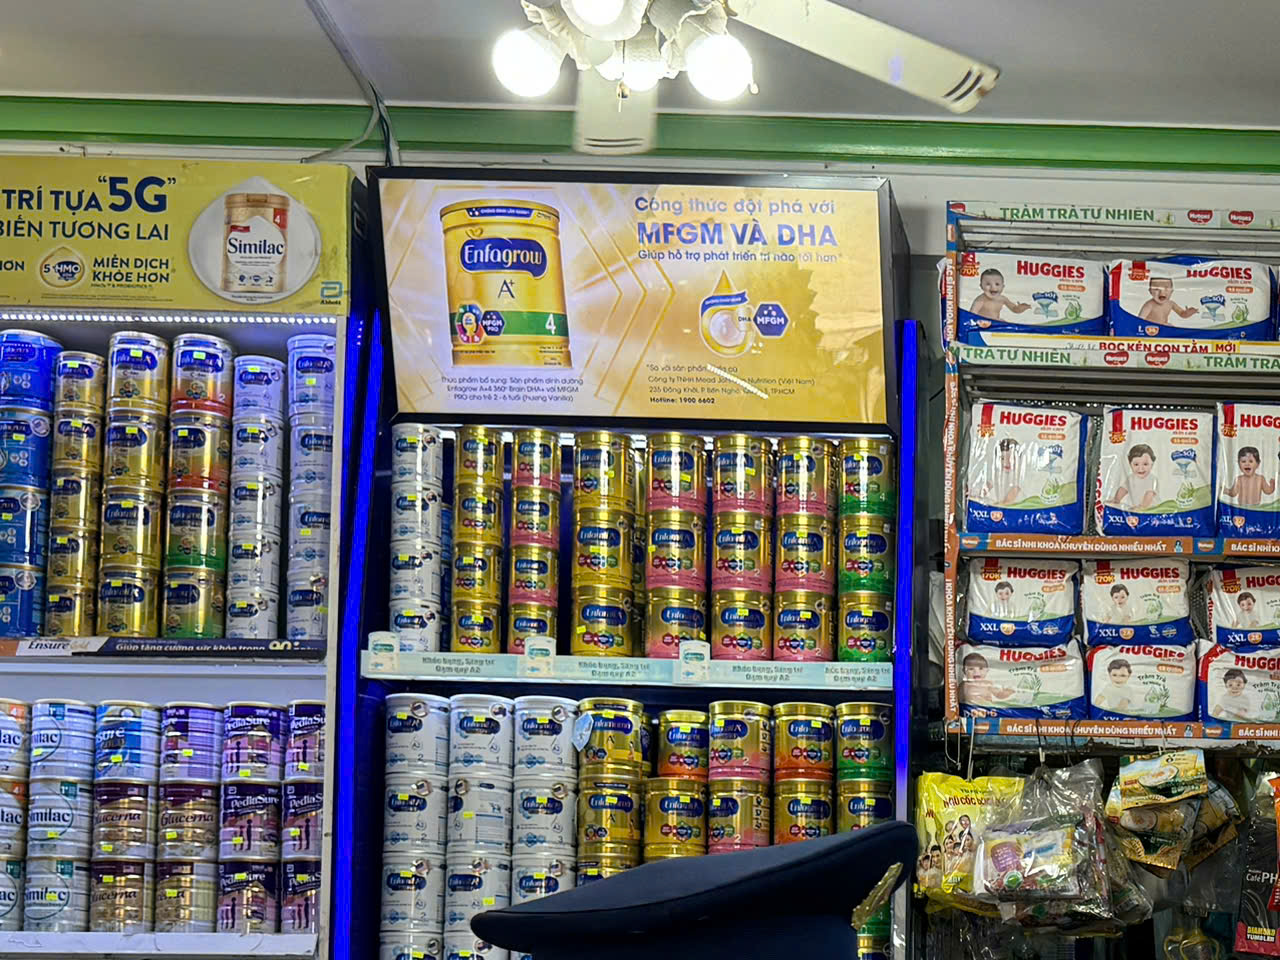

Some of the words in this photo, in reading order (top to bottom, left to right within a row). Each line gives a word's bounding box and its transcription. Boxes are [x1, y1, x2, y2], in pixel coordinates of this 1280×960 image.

[2, 185, 43, 210] TRÍ
[50, 189, 103, 216] TỰA
[634, 196, 683, 216] Công
[689, 197, 728, 212] thức
[734, 199, 762, 216] đột
[769, 199, 803, 216] phá
[809, 200, 835, 214] với
[1000, 204, 1044, 219] TRÀM
[1047, 205, 1079, 220] TRÀ
[1105, 207, 1155, 221] NHIÊN
[49, 220, 130, 240] TƯƠNG
[136, 223, 169, 240] LAI
[637, 221, 724, 245] MFGM
[730, 218, 768, 246] VÀ
[777, 224, 838, 246] DHA
[227, 237, 285, 255] Similac
[464, 244, 543, 267] Enfagrow
[638, 249, 666, 261] Giúp
[685, 250, 701, 261] trợ
[703, 250, 730, 263] phát
[134, 258, 170, 271] DỊCH
[1017, 260, 1086, 279] HUGGIES
[93, 269, 133, 282] KHỎE
[136, 272, 170, 283] HƠN
[1186, 267, 1253, 281] HUGGIES
[545, 313, 557, 335] 4
[757, 316, 785, 325] MFGM
[1000, 411, 1067, 427] HUGGIES
[1131, 417, 1199, 431] HUGGIES
[996, 540, 1012, 549] BÁC
[1022, 541, 1037, 549] NHI
[1037, 541, 1060, 550] KHOA
[1061, 541, 1094, 551] KHUYÊN
[1095, 541, 1117, 551] DÙNG
[1231, 543, 1248, 552] BÁC
[1007, 566, 1067, 580] HUGGIES
[1120, 567, 1180, 580] HUGGIES
[980, 623, 999, 631] XXL
[1099, 629, 1118, 637] XXL
[27, 638, 70, 651] Ensure
[231, 794, 279, 809] PediaSure
[161, 806, 214, 827] Glucerna
[1247, 926, 1276, 936] DIAMOND
[1247, 935, 1275, 943] TUMBLER
